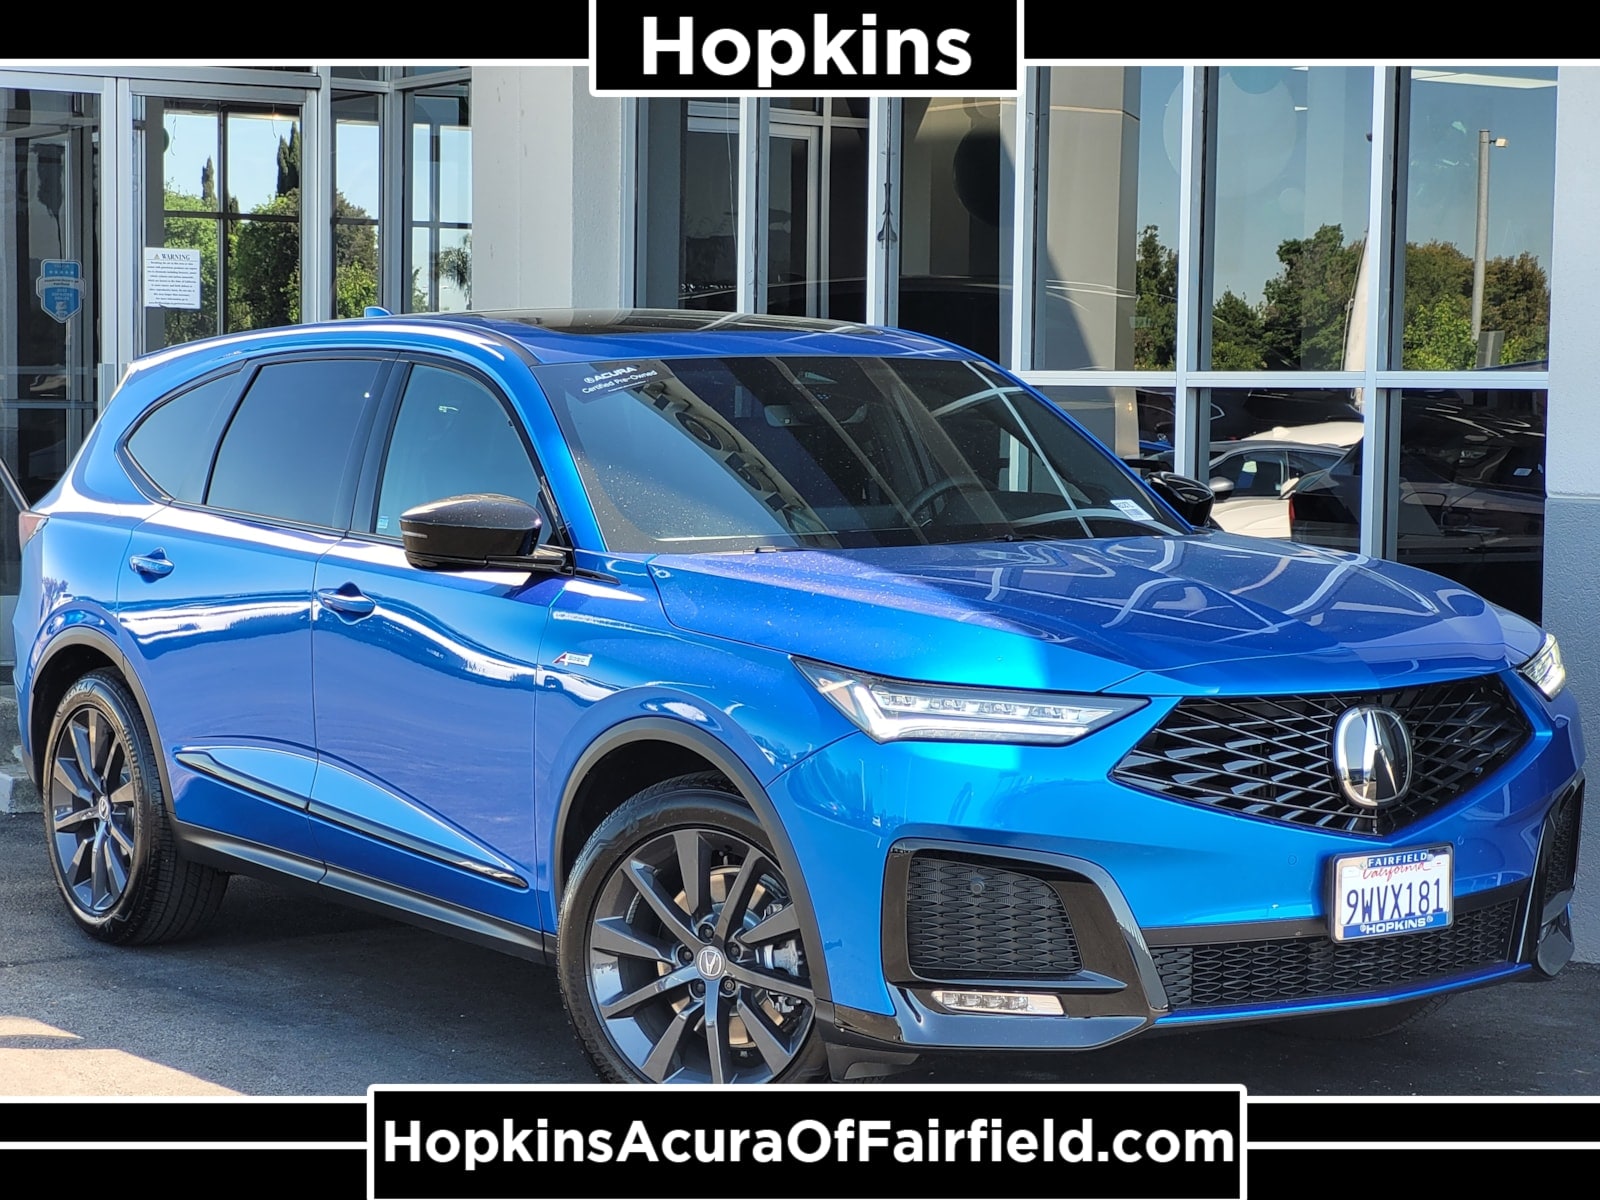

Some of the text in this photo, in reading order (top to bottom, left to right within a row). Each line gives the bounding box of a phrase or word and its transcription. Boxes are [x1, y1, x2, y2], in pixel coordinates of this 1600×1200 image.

[582, 381, 616, 394] Certified
[614, 370, 658, 385] Pre-Owned
[594, 367, 637, 381] ACURA
[1368, 852, 1427, 867] FAIRFIELD
[1362, 861, 1432, 882] California
[1347, 878, 1443, 924] 9WVX181
[1365, 917, 1427, 935] HOPKINS
